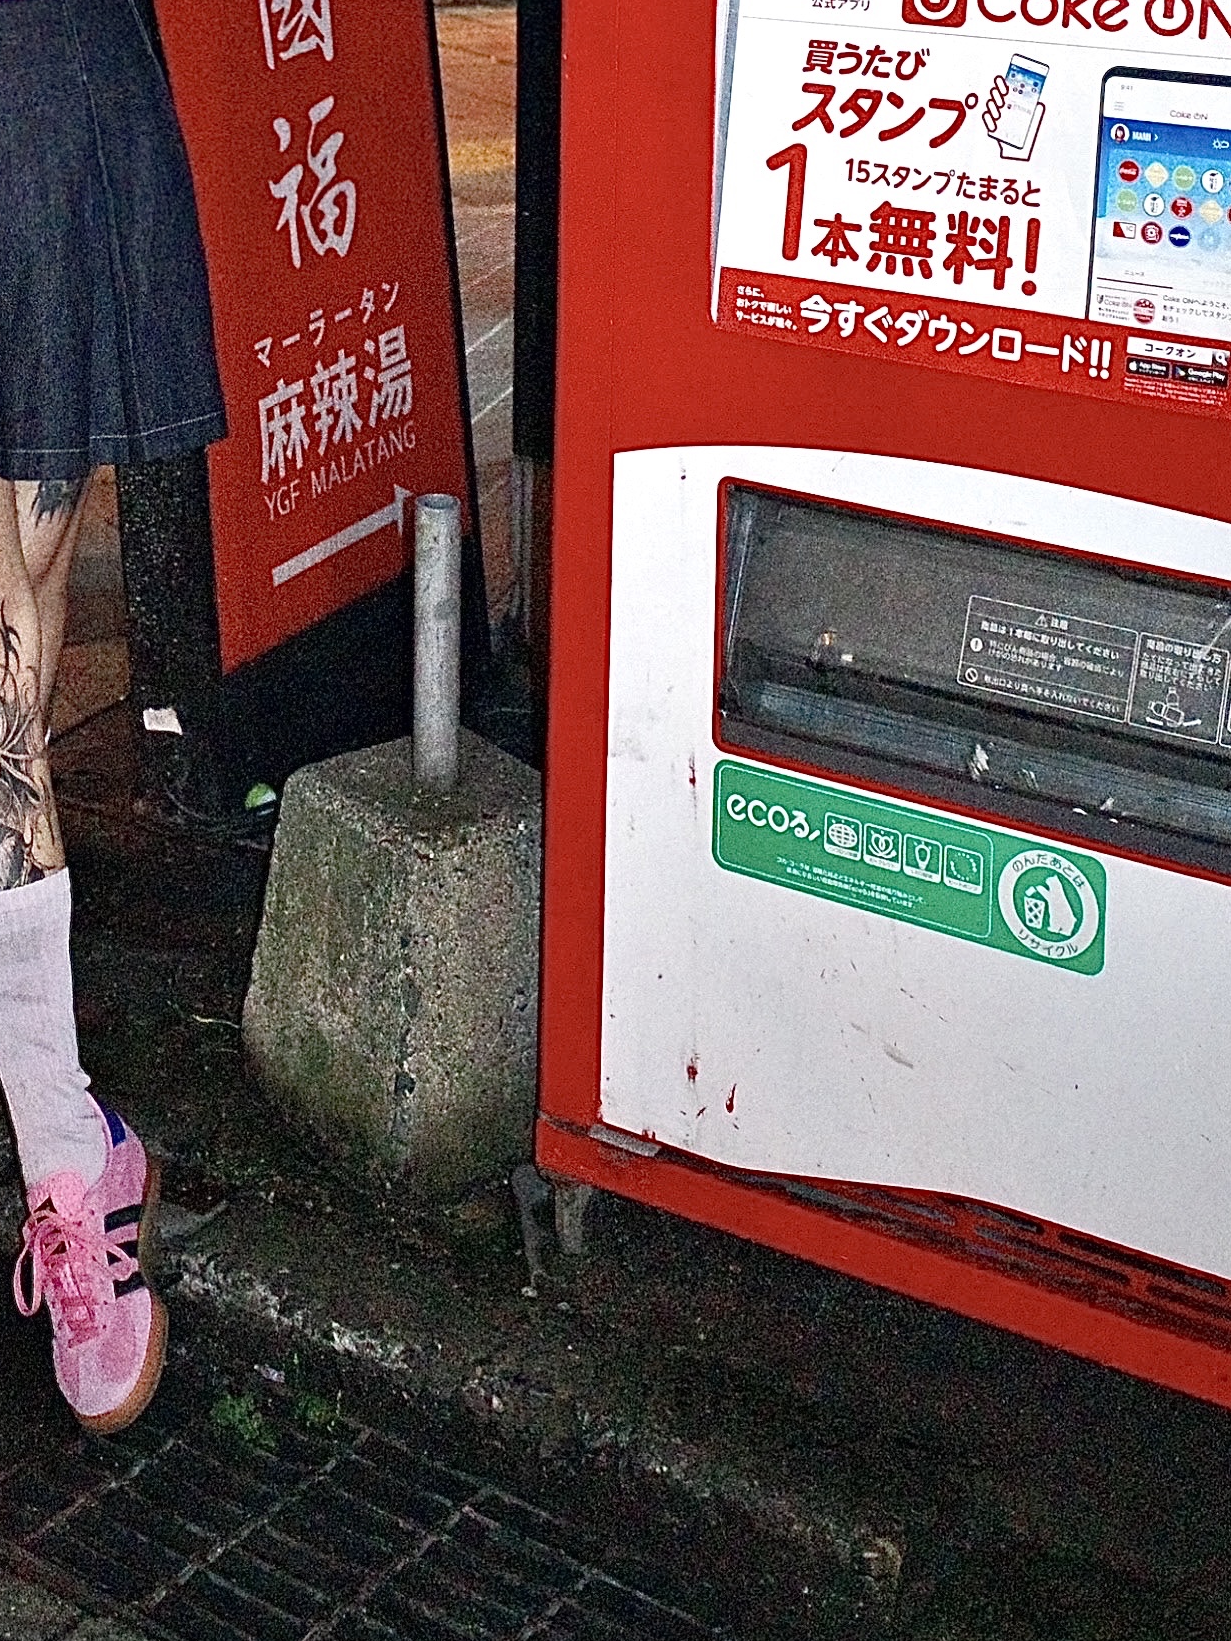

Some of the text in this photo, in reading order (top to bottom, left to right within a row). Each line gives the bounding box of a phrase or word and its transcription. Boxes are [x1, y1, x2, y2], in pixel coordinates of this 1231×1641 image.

[803, 39, 930, 80] 買うたび
[792, 82, 979, 148] スタンプ
[845, 158, 1040, 207] 15スタンプたまると
[766, 143, 1040, 296] 1本無料!
[253, 280, 401, 367] マーラータン
[799, 294, 1112, 379] 今すぐダウンロード!!
[1144, 343, 1197, 358] コークオン
[259, 323, 414, 487] 麻辣湯
[264, 418, 417, 524] YGF MALATANG
[1011, 852, 1085, 889] のんだあとは
[1017, 929, 1079, 958] リサイクル
